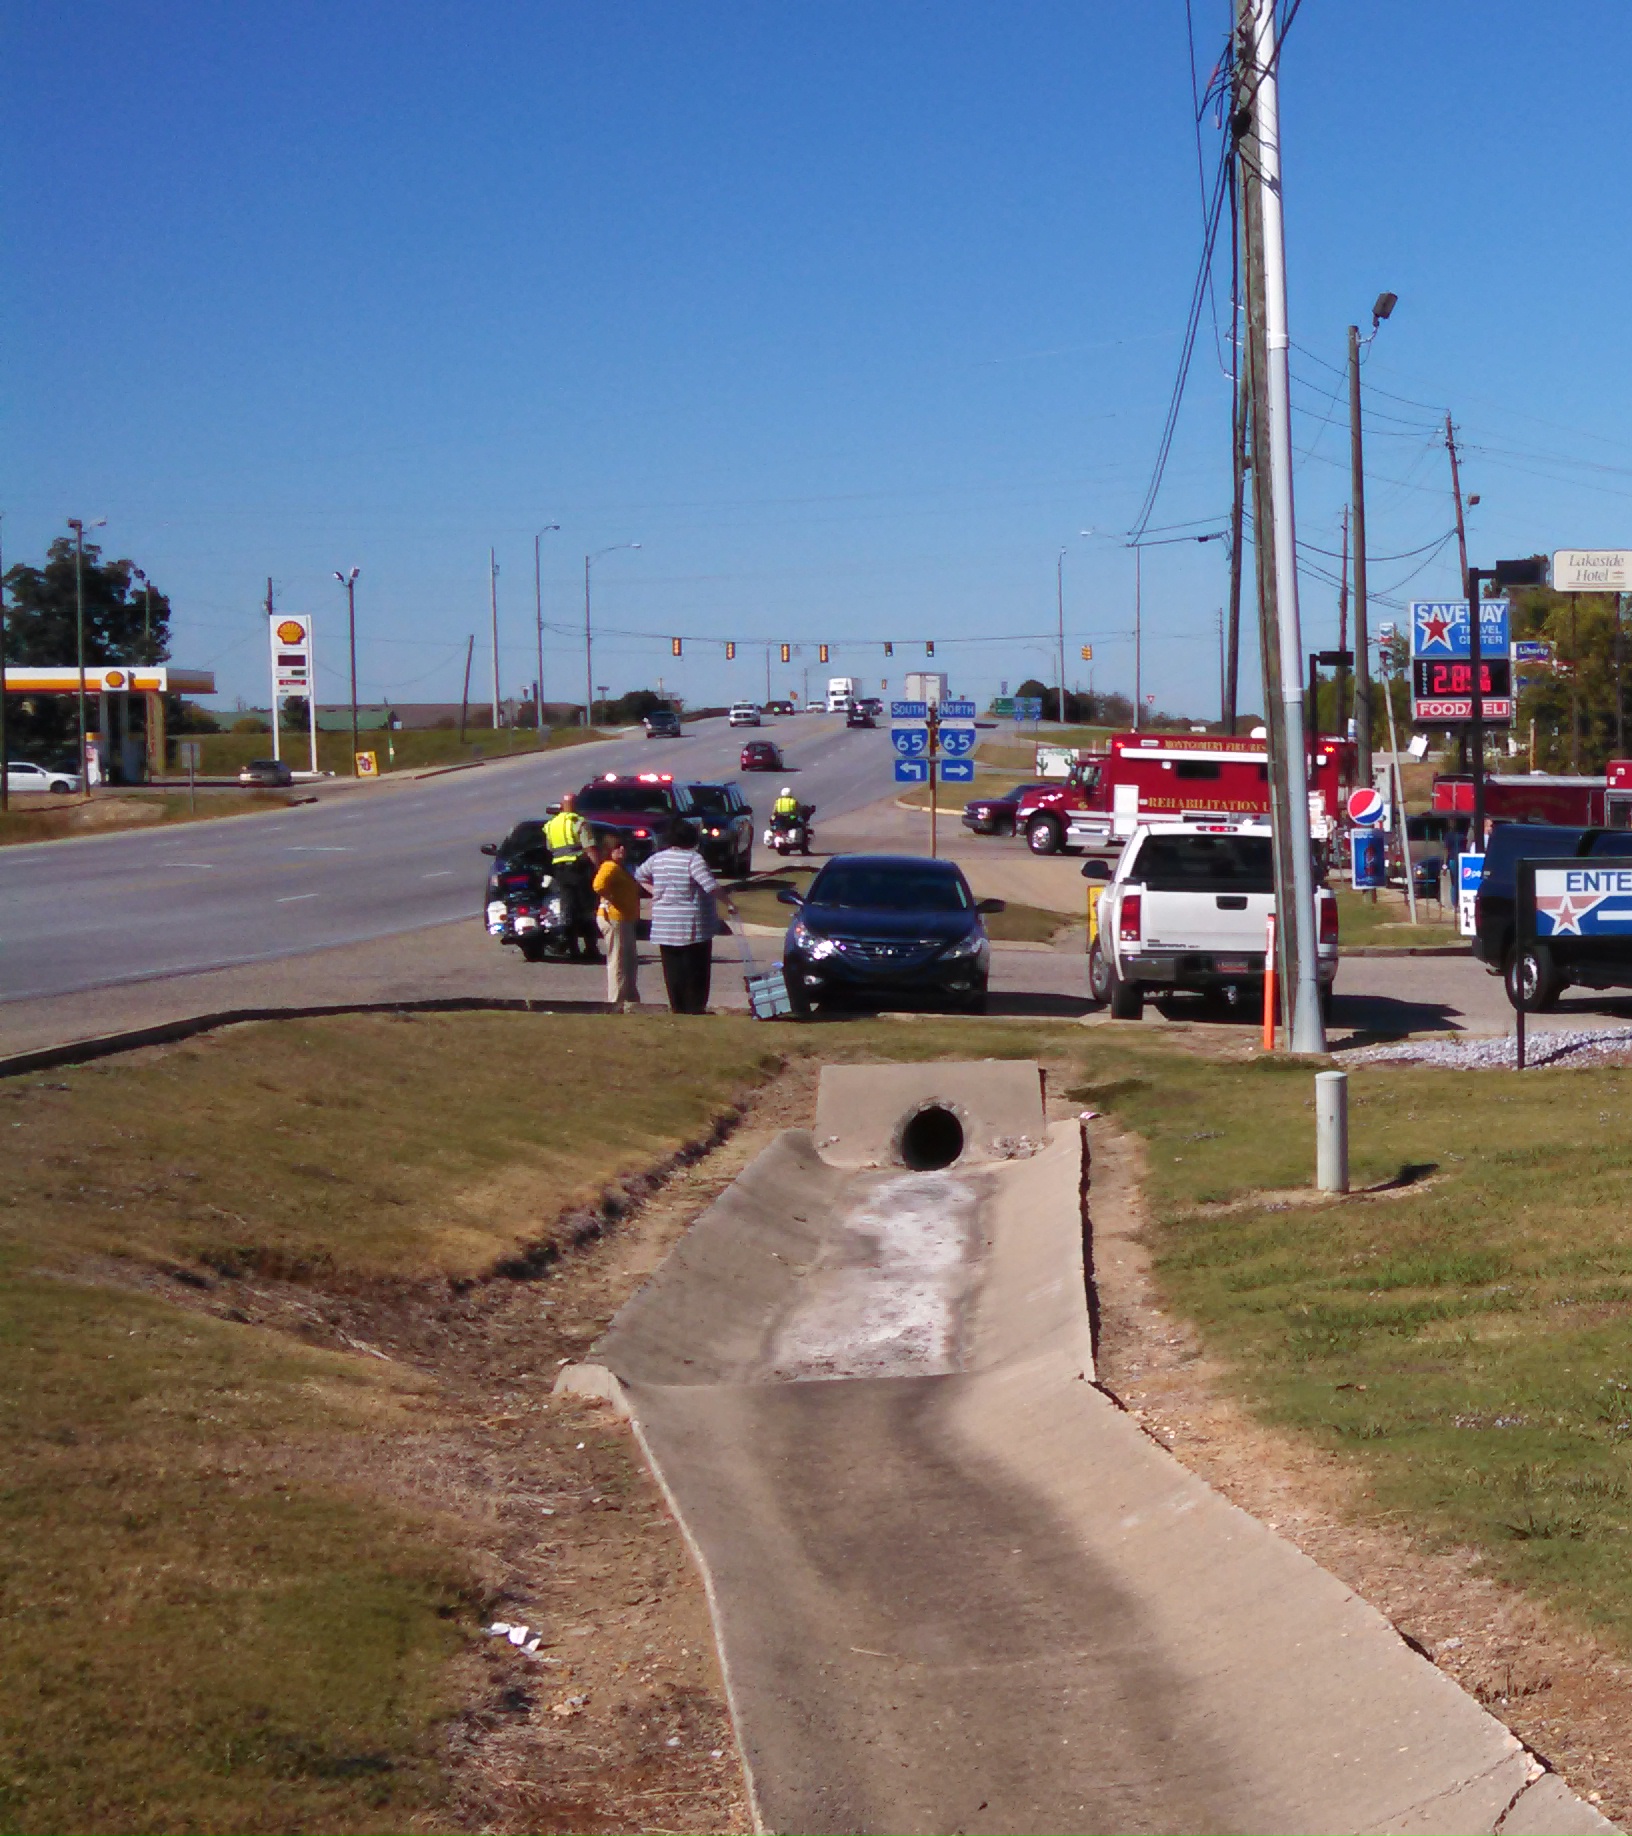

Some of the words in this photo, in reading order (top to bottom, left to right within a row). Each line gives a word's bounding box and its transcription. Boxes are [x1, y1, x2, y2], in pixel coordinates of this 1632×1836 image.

[1569, 553, 1625, 567] Lakeside
[1576, 569, 1609, 582] Hotel
[1459, 625, 1502, 635] TVEL
[1459, 635, 1503, 645] CTER
[892, 703, 925, 715] SOUTH
[940, 702, 974, 715] NORTH
[1419, 703, 1507, 716] FOOD/ELI
[897, 734, 923, 751] 65
[943, 734, 970, 751] 65
[1164, 739, 1223, 751] MONTGOMERY
[1148, 797, 1258, 811] REHABILITATION
